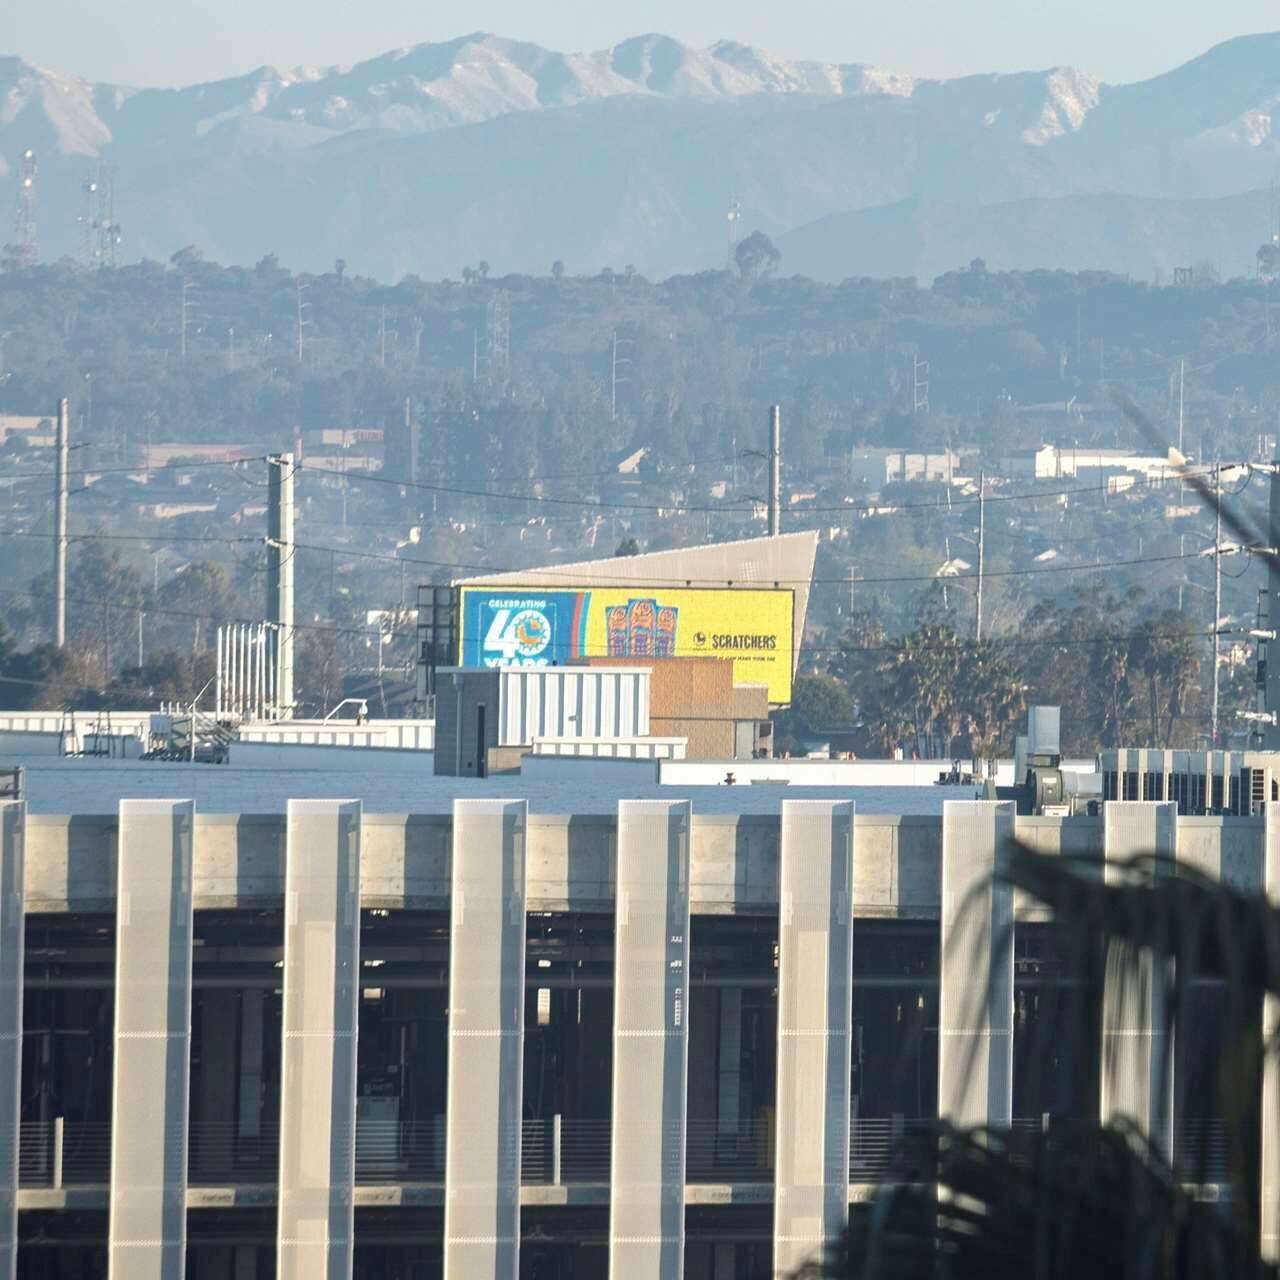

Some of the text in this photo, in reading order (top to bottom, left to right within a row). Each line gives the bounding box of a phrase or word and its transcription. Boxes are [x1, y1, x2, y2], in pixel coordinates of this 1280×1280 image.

[488, 600, 546, 609] CELEBRATING
[483, 609, 551, 657] 40
[712, 634, 776, 649] SCRATCHERS
